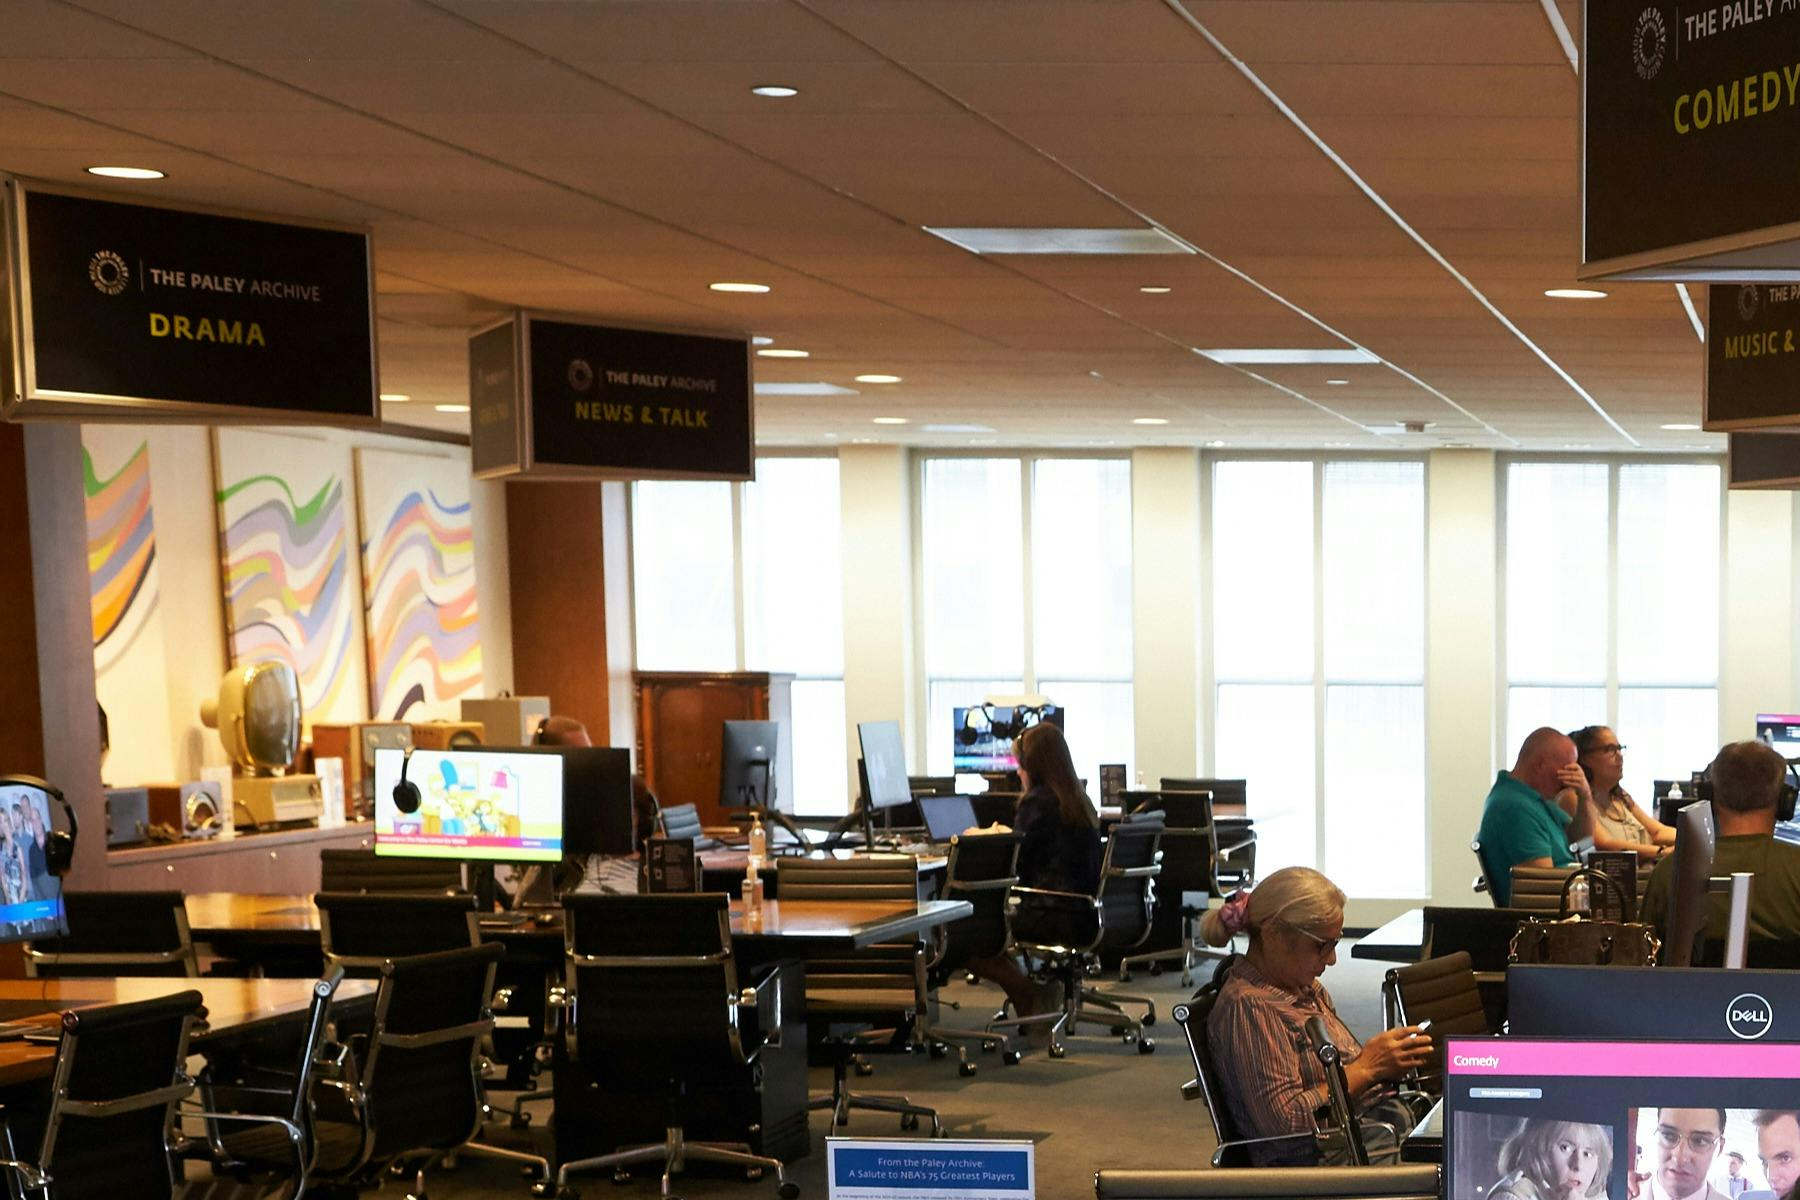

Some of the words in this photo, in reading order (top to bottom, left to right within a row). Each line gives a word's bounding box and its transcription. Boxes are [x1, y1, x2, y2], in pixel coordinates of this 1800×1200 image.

[1685, 9, 1716, 41] THE
[1722, 0, 1774, 31] PALEY
[150, 269, 186, 287] THE
[191, 273, 245, 293] PALEY
[250, 280, 320, 302] ARCHIVE
[1769, 286, 1788, 303] THE
[150, 313, 265, 346] DRAMA
[1725, 331, 1778, 359] MUSIC
[1784, 329, 1795, 352] &
[606, 370, 628, 385] THE
[632, 372, 667, 388] PALEY
[670, 376, 716, 392] ARCHIVE
[575, 401, 633, 423] NEWS
[641, 405, 654, 425] &
[659, 407, 709, 428] TALK
[1732, 1010, 1767, 1022] DELL
[1454, 1055, 1499, 1069] Comedy
[878, 1158, 902, 1167] From
[904, 1159, 917, 1167] the
[922, 1159, 945, 1169] Paley
[948, 1159, 984, 1168] Archive:
[849, 1170, 855, 1178] A
[858, 1170, 886, 1179] Salute
[900, 1171, 927, 1179] NBA's
[929, 1172, 939, 1182] 75
[941, 1172, 980, 1181] Greatest
[983, 1172, 1015, 1182] Players
